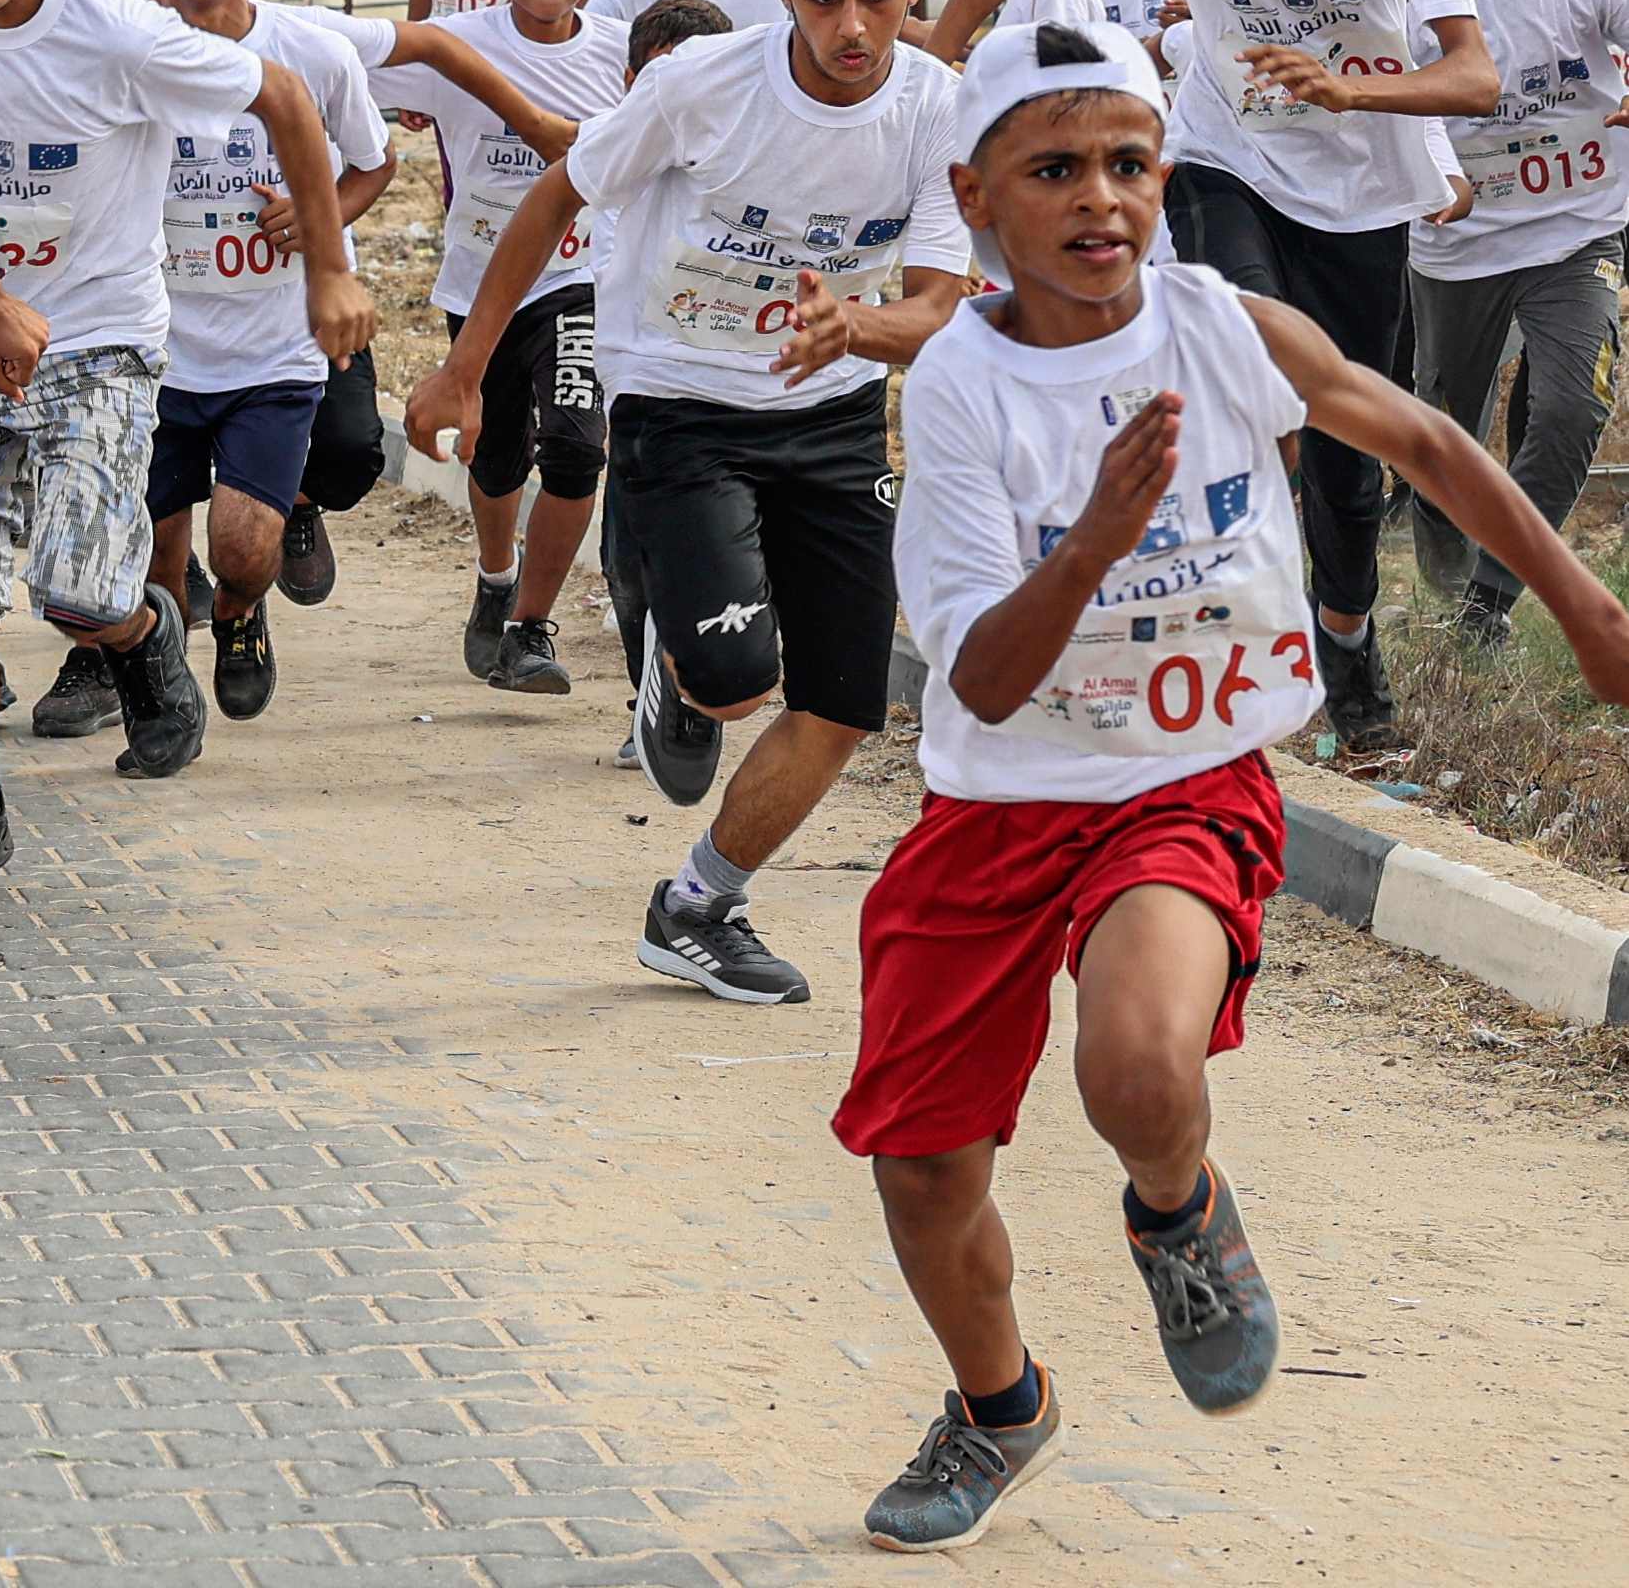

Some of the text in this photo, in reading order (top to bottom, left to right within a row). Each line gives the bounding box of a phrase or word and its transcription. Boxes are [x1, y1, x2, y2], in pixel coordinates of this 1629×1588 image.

[1287, 7, 1361, 40] ماراثون
[1514, 90, 1577, 121] ماراثون
[486, 147, 533, 168] الأمل
[1519, 140, 1606, 195] 013
